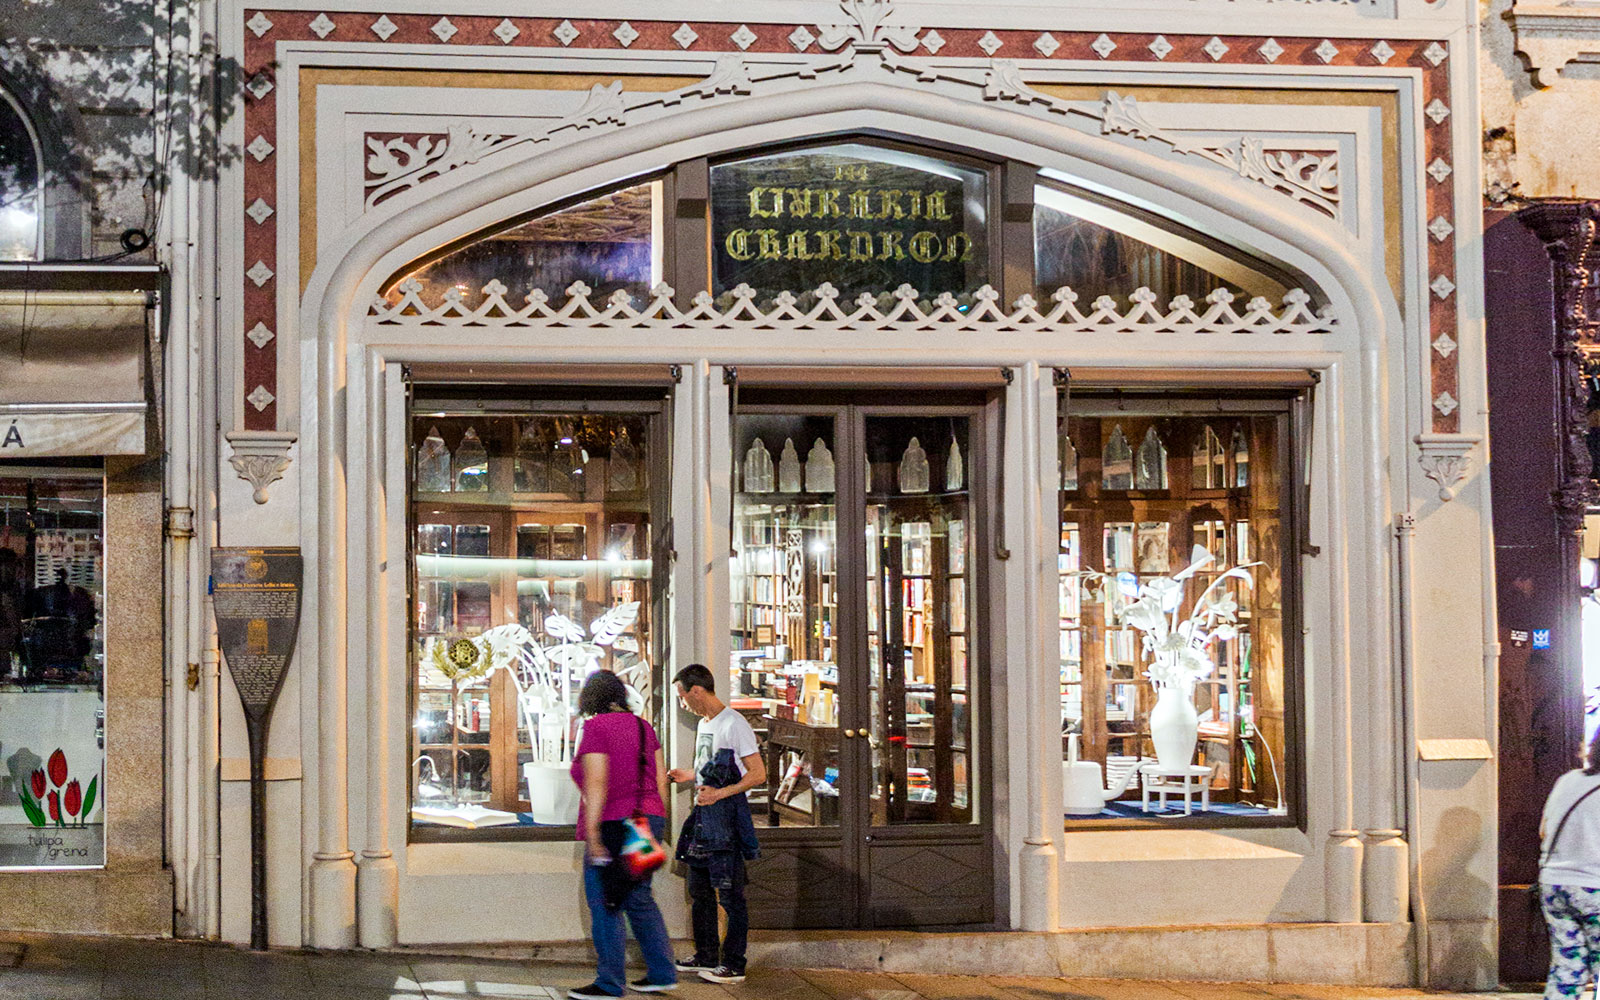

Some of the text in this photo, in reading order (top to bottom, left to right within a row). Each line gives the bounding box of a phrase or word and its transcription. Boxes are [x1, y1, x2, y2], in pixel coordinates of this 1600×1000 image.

[748, 187, 952, 221] LIVRARIA
[725, 228, 974, 263] CHARDRON
[28, 833, 64, 849] tulipa
